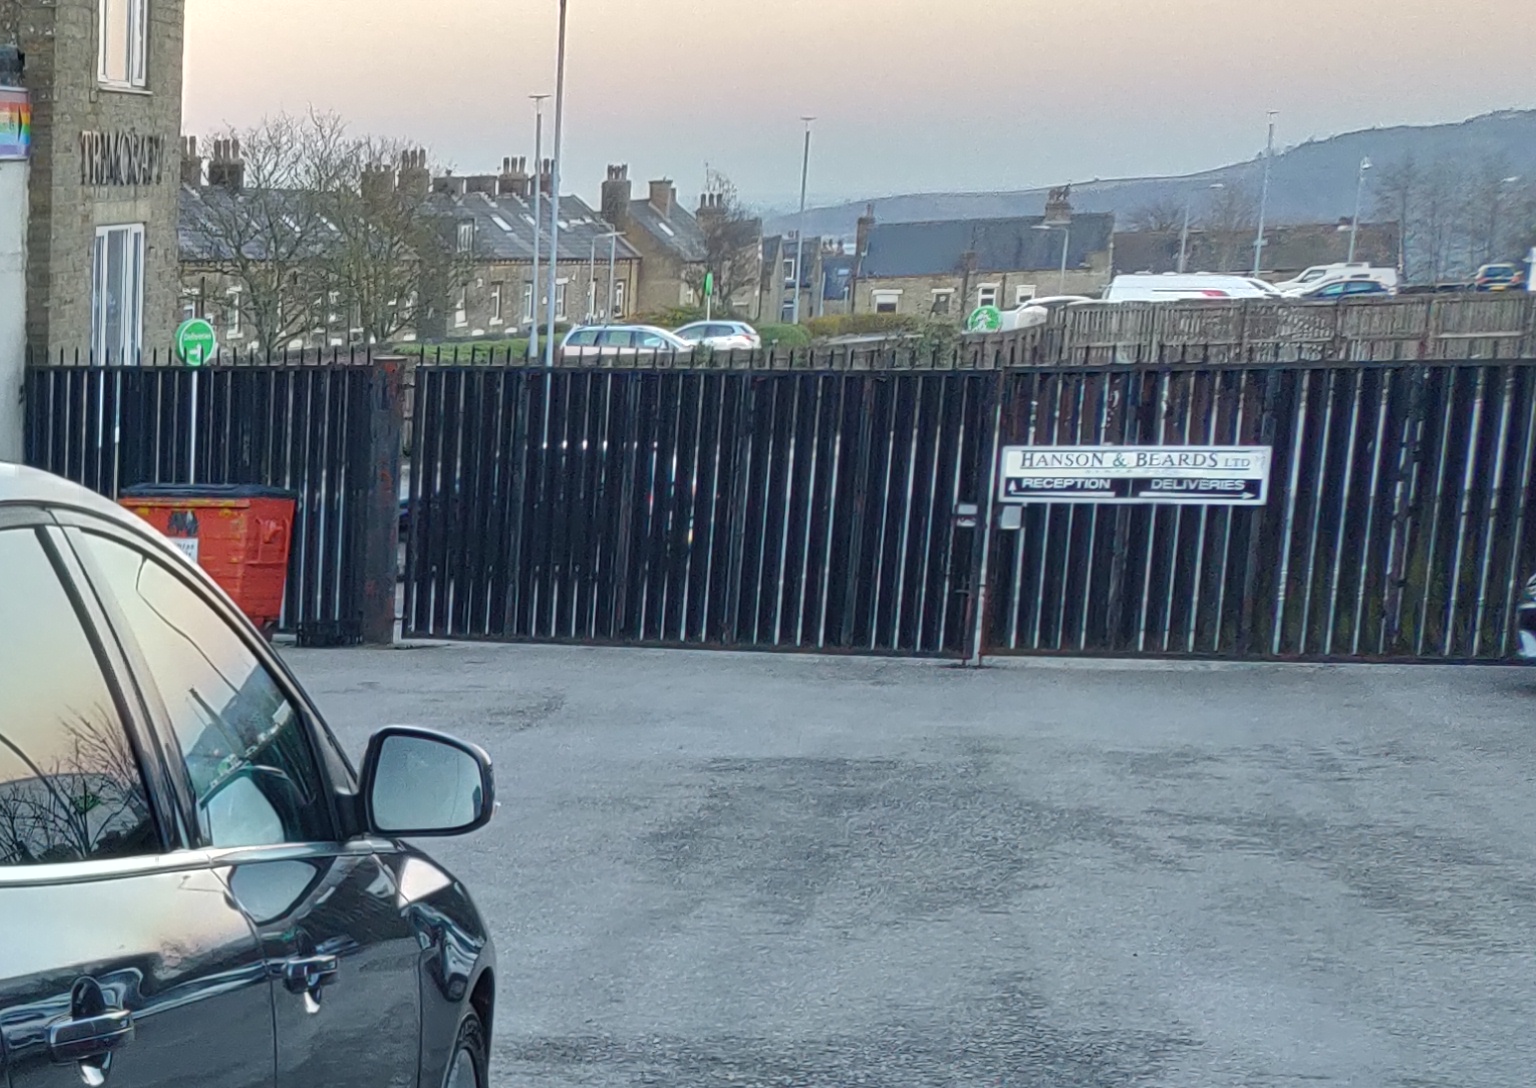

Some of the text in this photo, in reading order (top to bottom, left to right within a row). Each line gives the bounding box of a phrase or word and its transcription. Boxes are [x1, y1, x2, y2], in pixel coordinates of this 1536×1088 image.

[1112, 453, 1127, 468] &
[1223, 457, 1251, 468] LTD
[1022, 478, 1112, 490] RECEPTION
[1150, 479, 1246, 491] DELIVERIES
